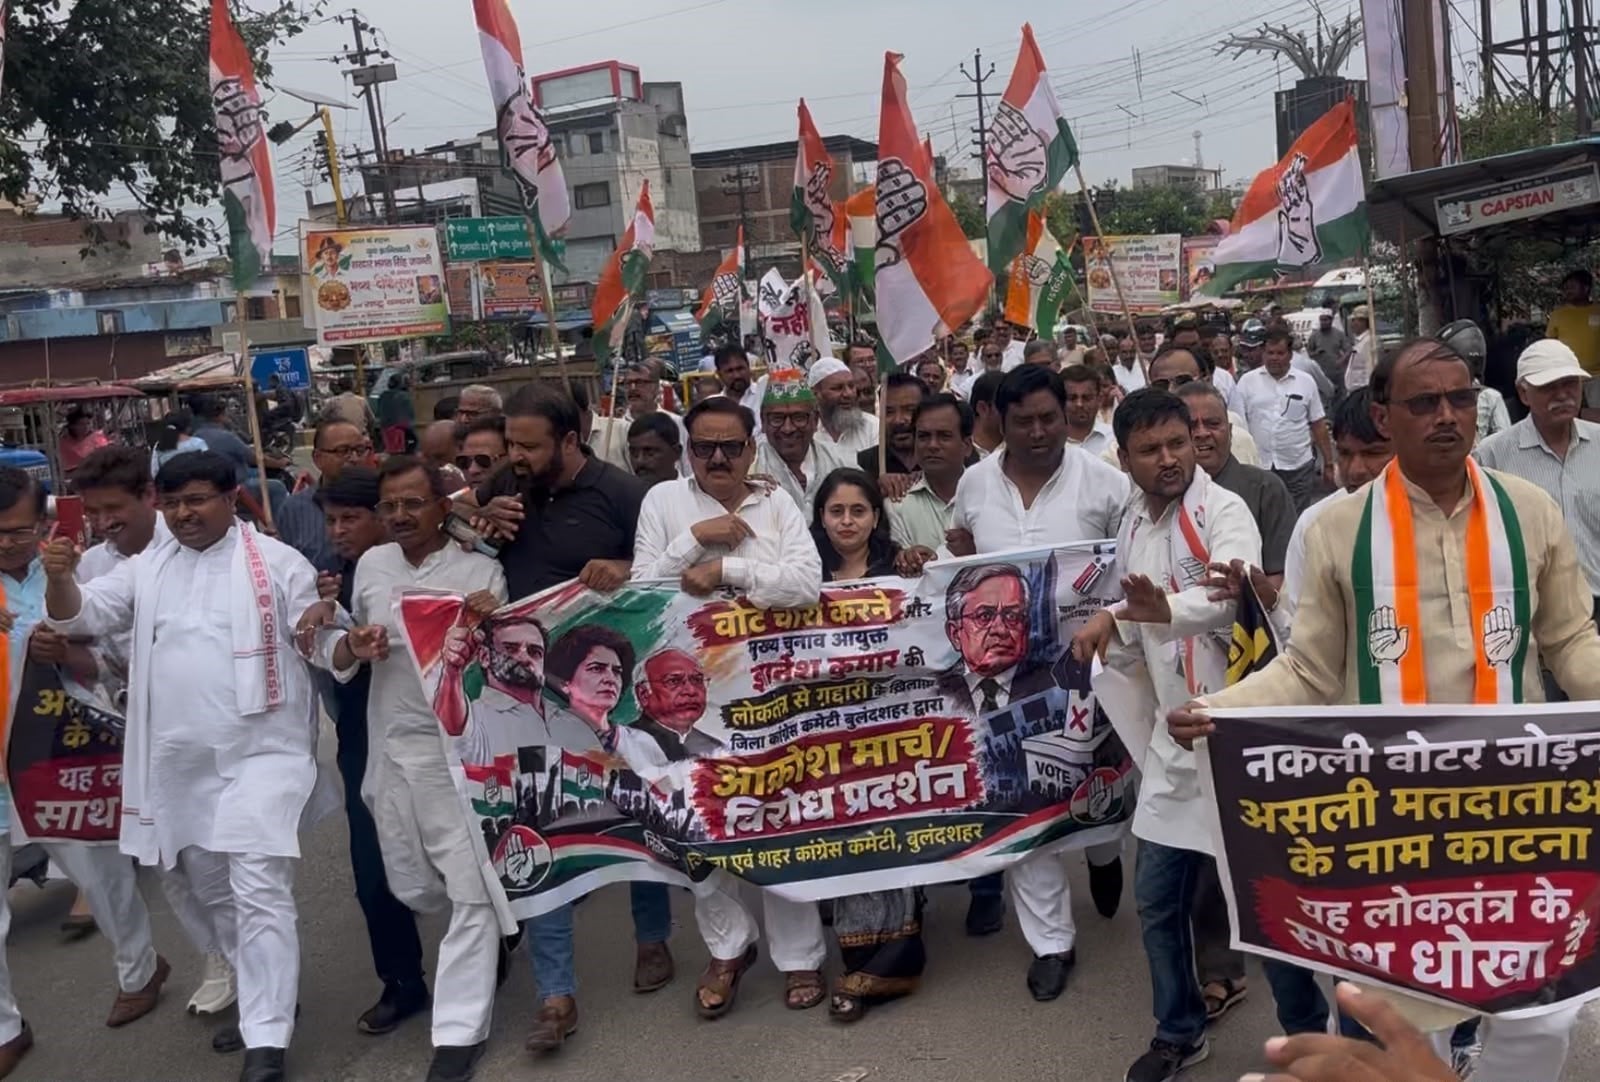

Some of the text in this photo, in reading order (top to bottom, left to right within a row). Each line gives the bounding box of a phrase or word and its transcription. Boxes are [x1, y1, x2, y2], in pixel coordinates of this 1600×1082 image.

[1481, 188, 1554, 217] CAPSTAN
[712, 599, 767, 637] वोट
[829, 589, 893, 625] करने
[263, 612, 280, 700] CONGRESS
[748, 626, 889, 661] मुख्य चुनाव आयुक्त
[827, 649, 901, 680] कुमार
[904, 645, 926, 667] की
[730, 692, 789, 728] लोकतंत्र
[792, 685, 811, 708] से
[731, 697, 944, 752] जिला कांग्रेस कमेटी बुलंदशहर द्वारा
[58, 765, 96, 792] यह
[712, 743, 842, 797] आक्रोश
[1035, 760, 1072, 785] VOTE
[1242, 732, 1374, 783] नकली
[1384, 731, 1487, 773] वोटर
[34, 797, 121, 831] साथ
[724, 759, 968, 837] विरोध प्रदर्शन
[1239, 777, 1379, 835] असली
[730, 849, 755, 873] एवं
[758, 847, 791, 869] शहर
[794, 837, 843, 863] कांग्रेस
[906, 822, 985, 853] बुलंदशहर
[1287, 827, 1592, 878] के नाम काटना
[1297, 877, 1573, 934] यह लोकतंत्र के
[1284, 917, 1396, 975] साथ
[1411, 924, 1554, 989] धोखा
